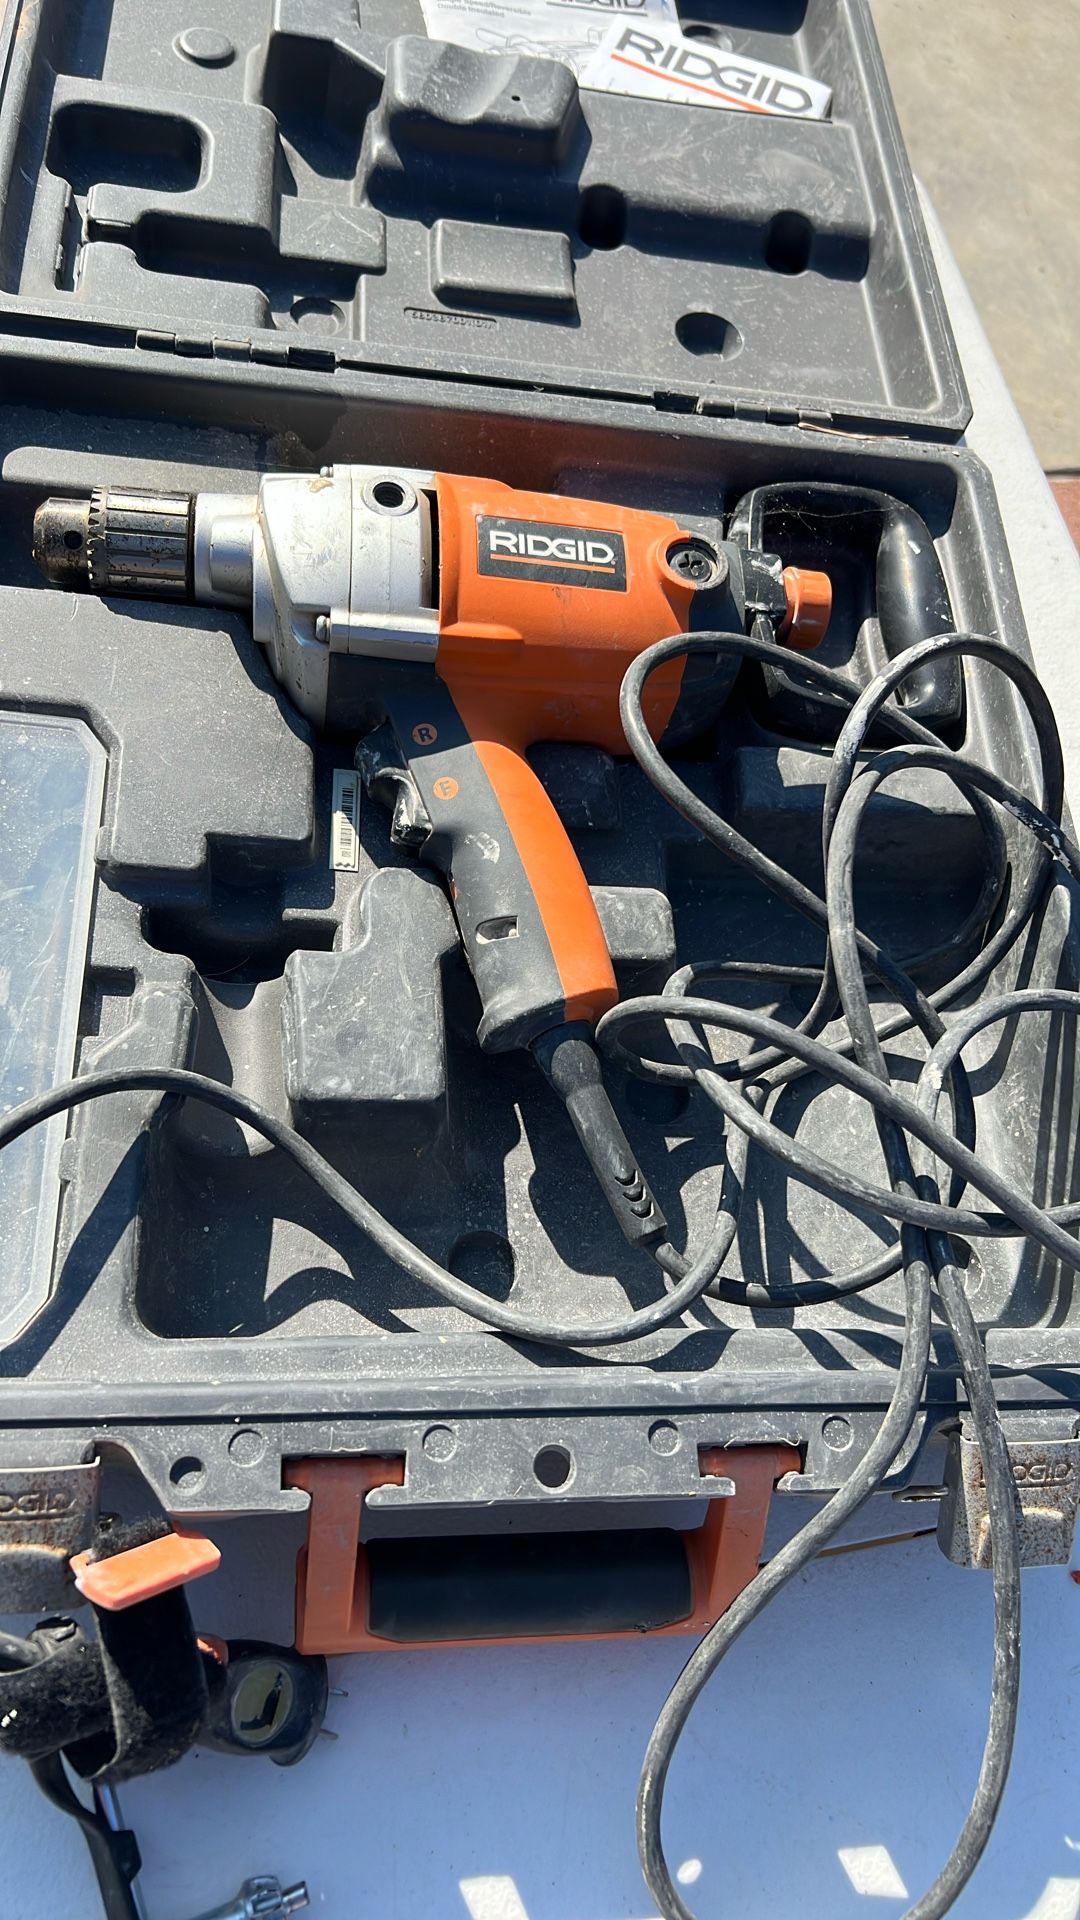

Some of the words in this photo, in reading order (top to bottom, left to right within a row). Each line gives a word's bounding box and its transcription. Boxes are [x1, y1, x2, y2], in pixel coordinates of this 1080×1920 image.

[615, 27, 813, 114] RIDGID
[489, 530, 615, 565] RIDGID
[417, 727, 434, 742] R
